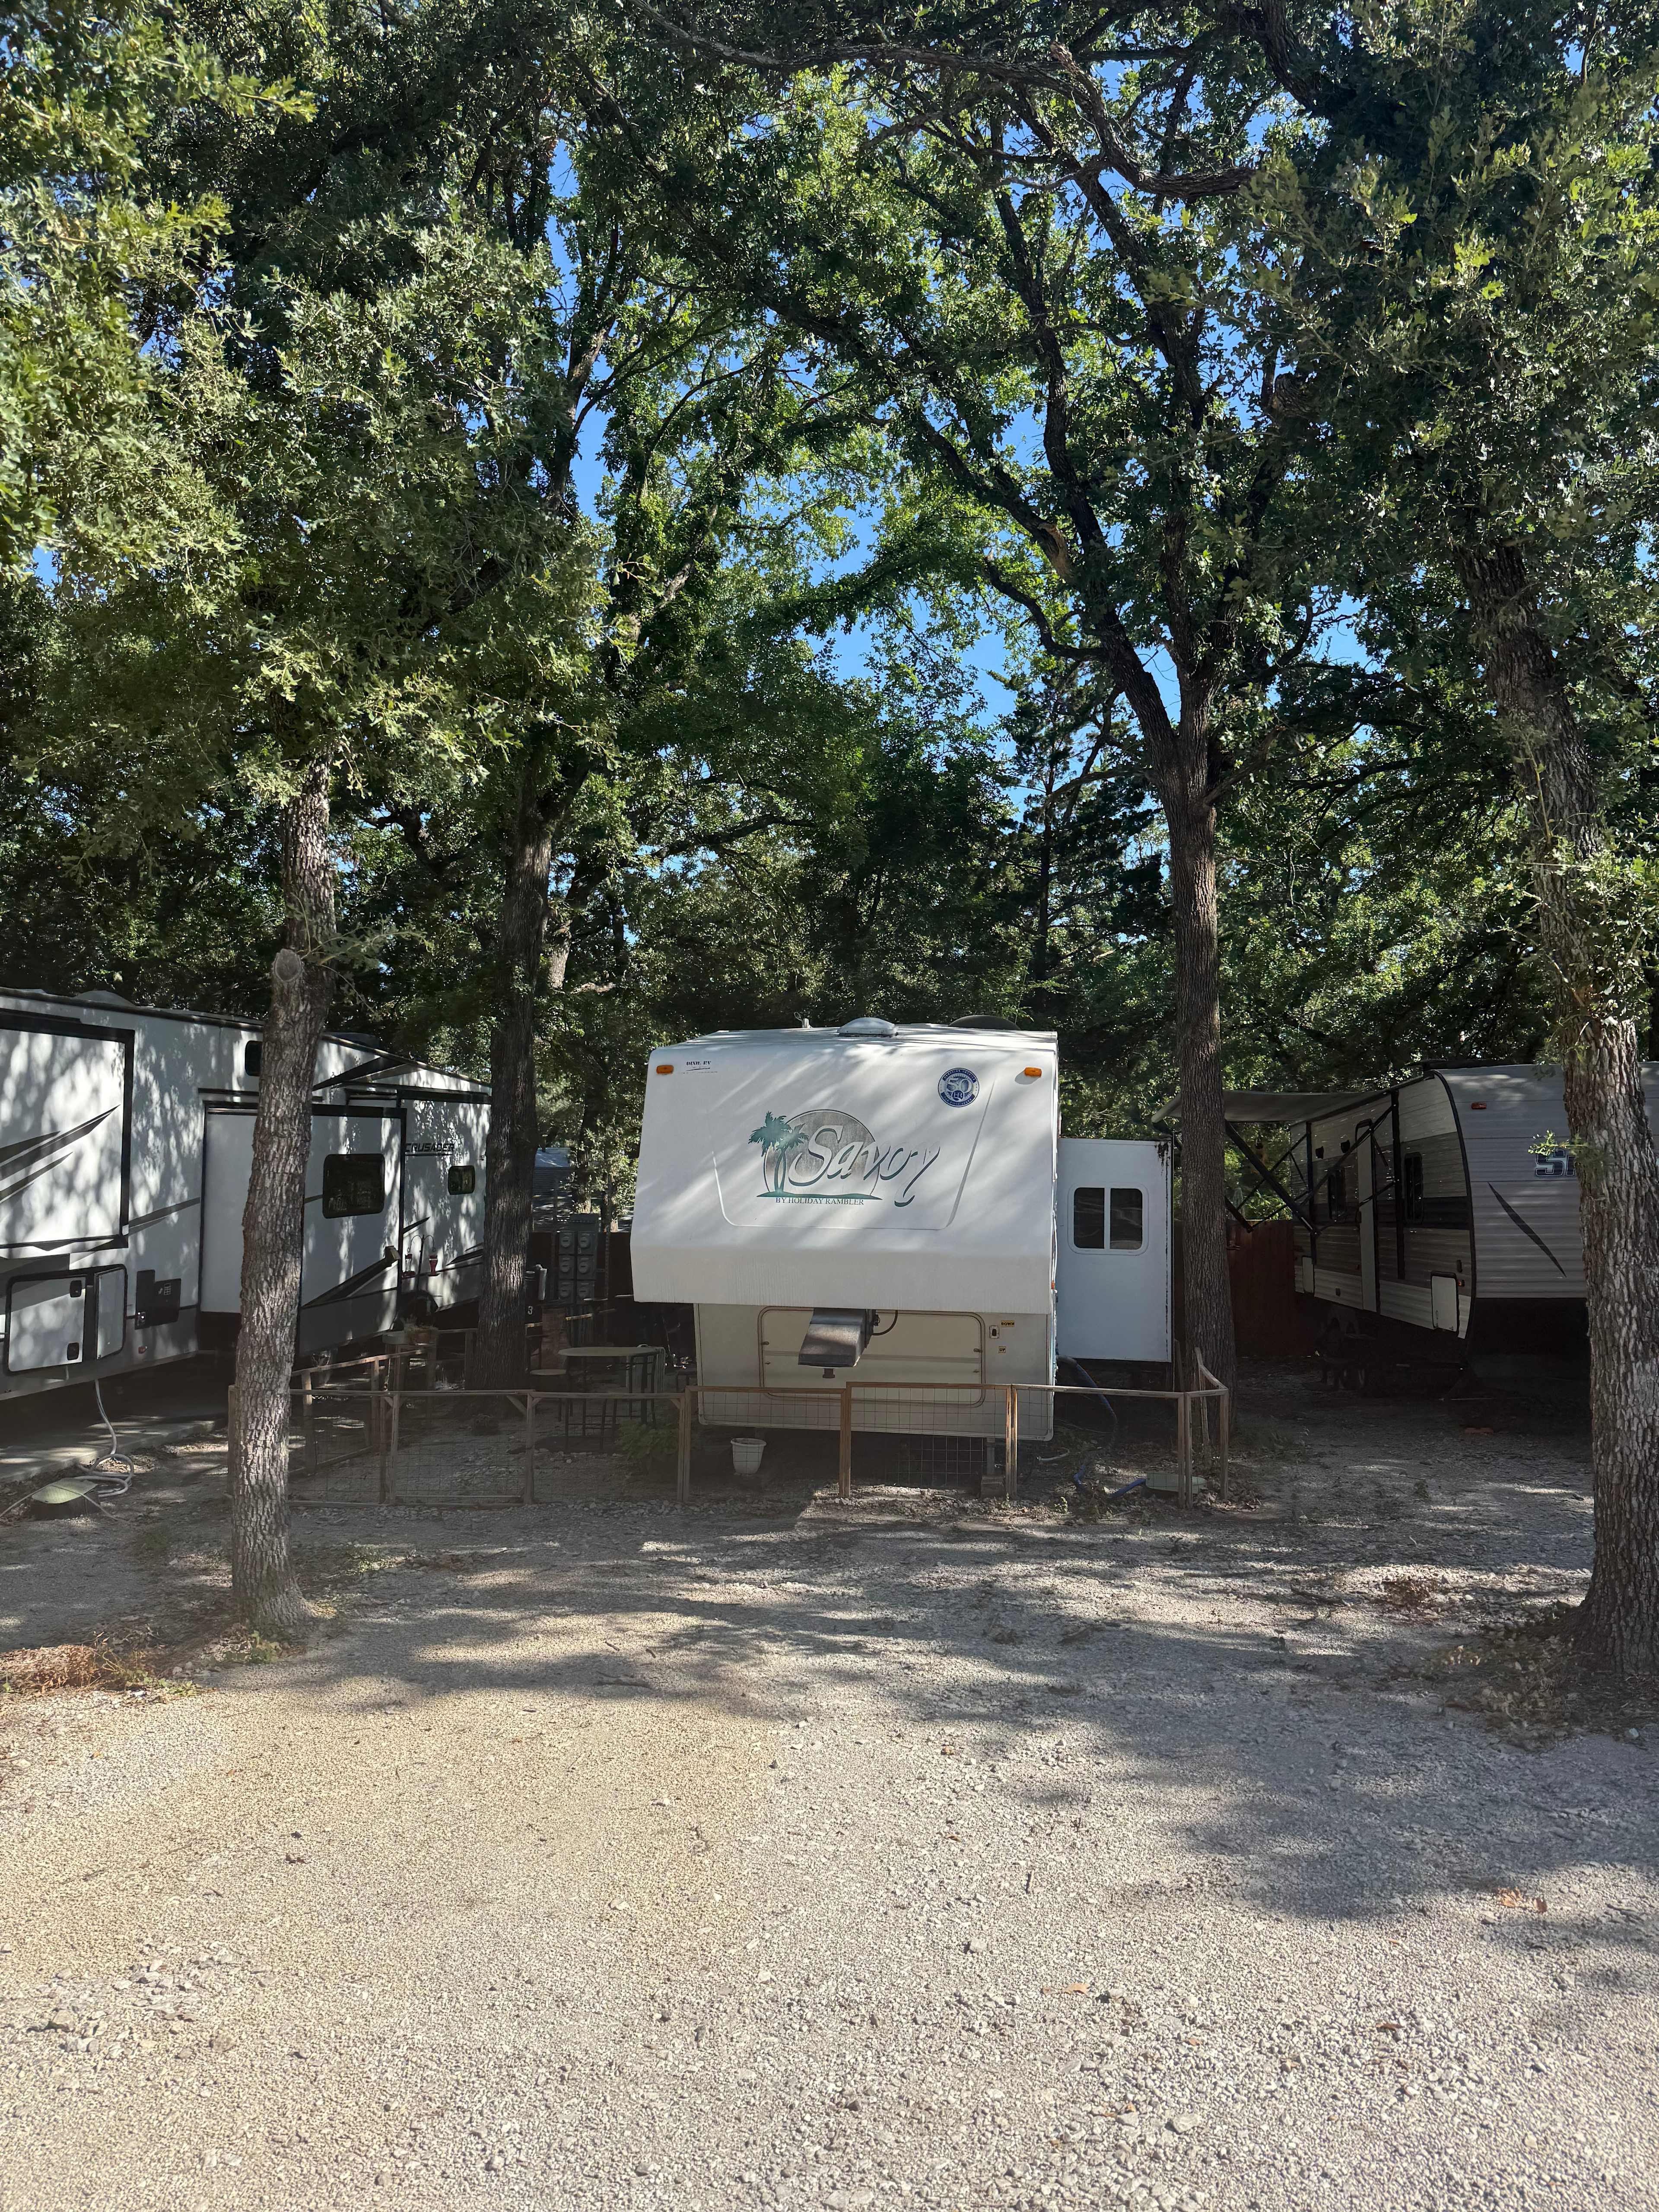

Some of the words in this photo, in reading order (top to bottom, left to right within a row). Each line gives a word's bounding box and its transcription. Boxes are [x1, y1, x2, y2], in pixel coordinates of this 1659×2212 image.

[406, 1143, 454, 1152] CRUSADER
[788, 1125, 941, 1207] Savoy
[528, 1306, 533, 1315] 3
